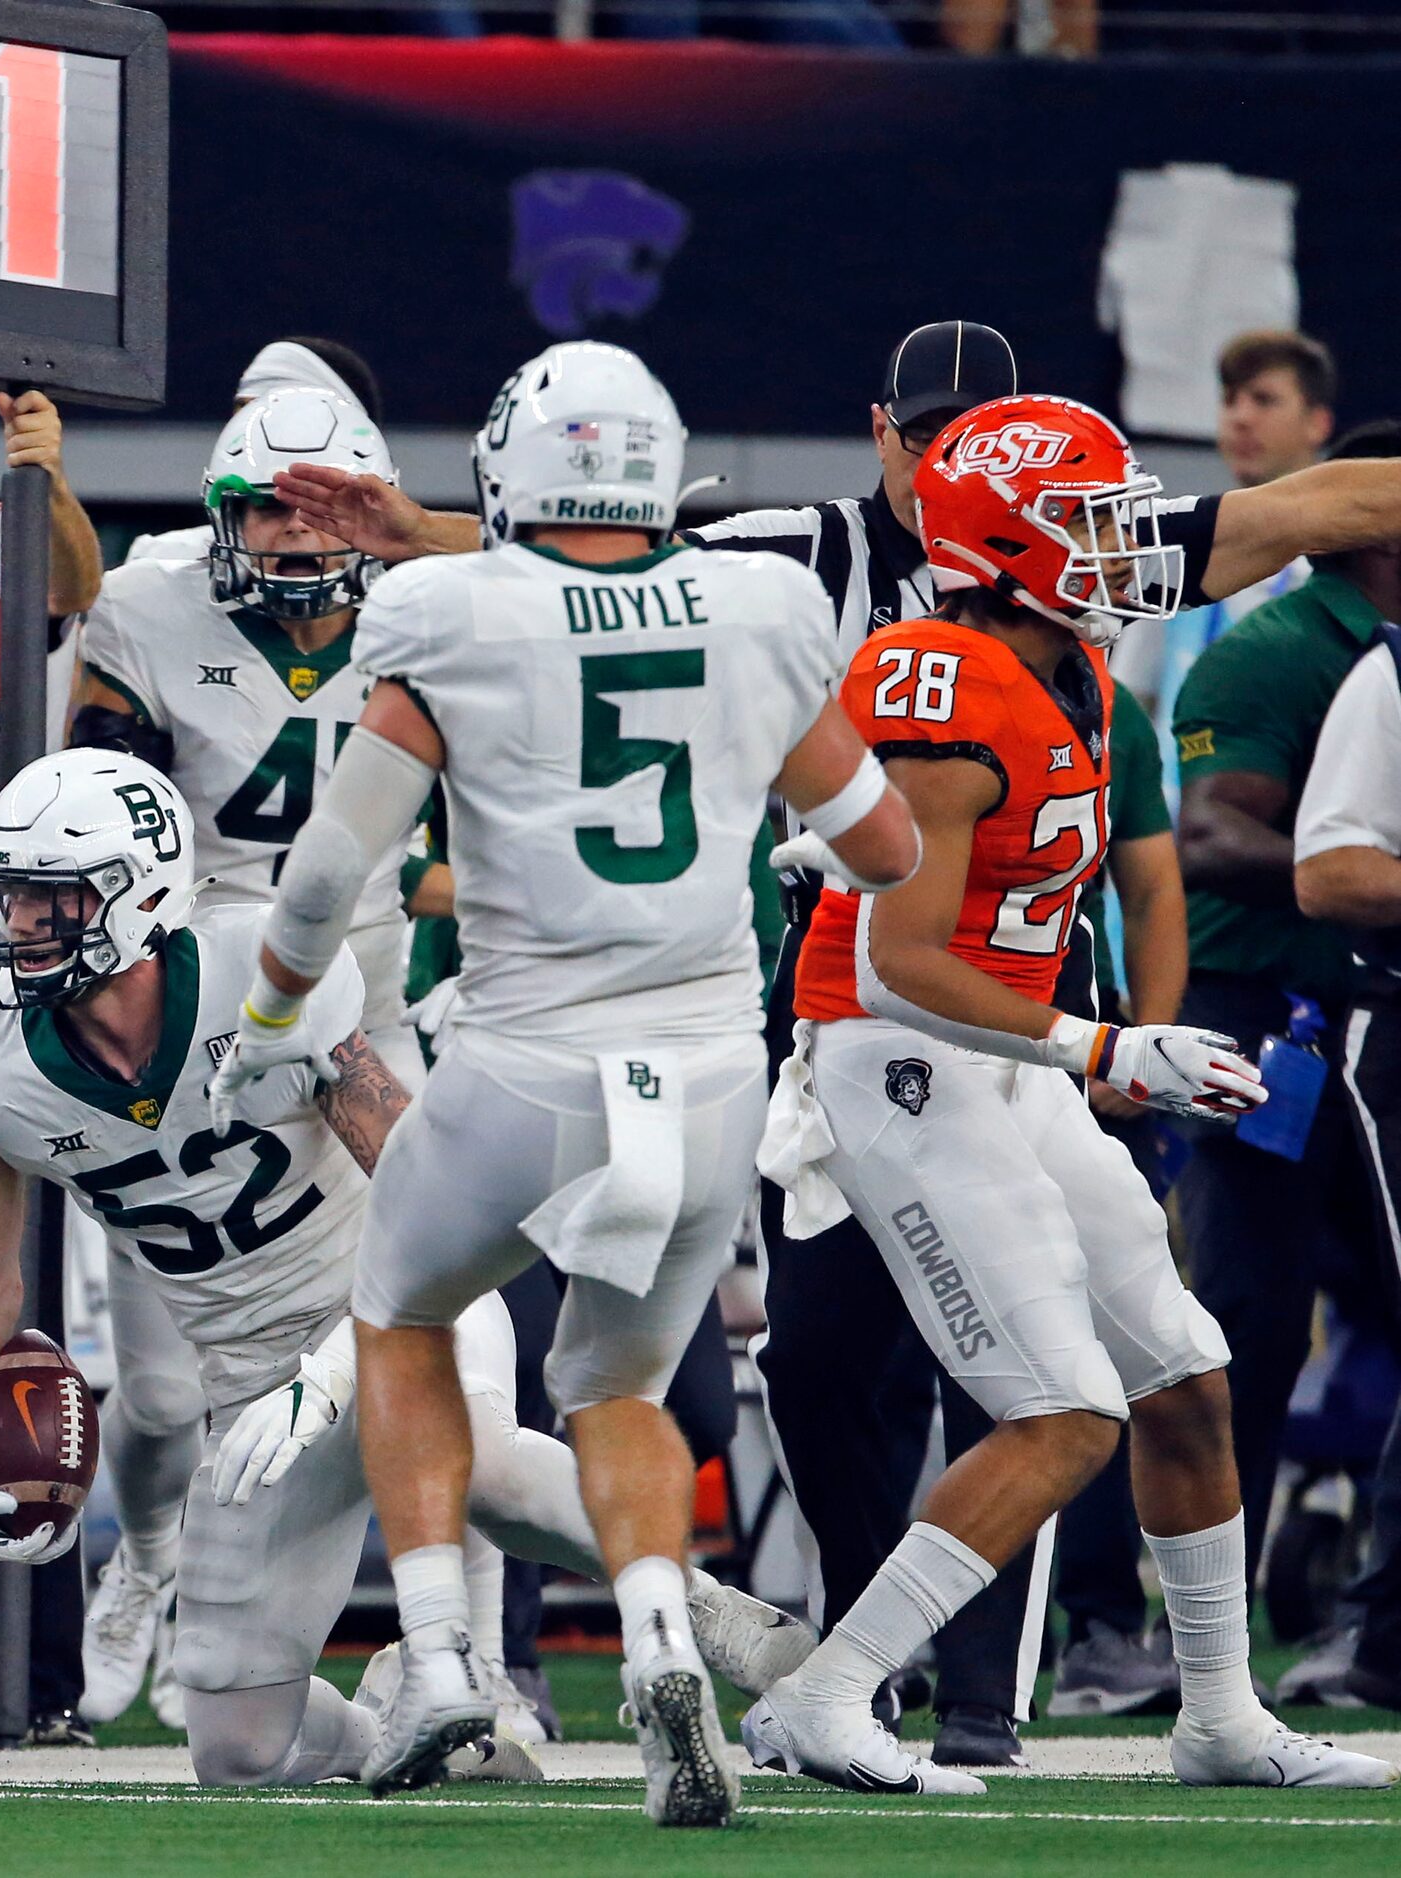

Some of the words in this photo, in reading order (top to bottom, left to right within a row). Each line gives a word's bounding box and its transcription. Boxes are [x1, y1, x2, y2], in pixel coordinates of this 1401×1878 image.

[962, 422, 1071, 478] OSU
[557, 498, 654, 521] Riddell
[563, 579, 709, 633] DOYLE
[198, 664, 239, 687] XII
[874, 648, 964, 723] 28
[575, 648, 705, 885] 5
[1048, 744, 1073, 773] XII
[113, 783, 182, 862] BU
[214, 717, 357, 887] 4
[987, 784, 1111, 956] 2
[625, 1061, 660, 1099] BU
[43, 1131, 91, 1158] XII
[70, 1120, 325, 1274] 52
[892, 1201, 997, 1361] COWBOYS
